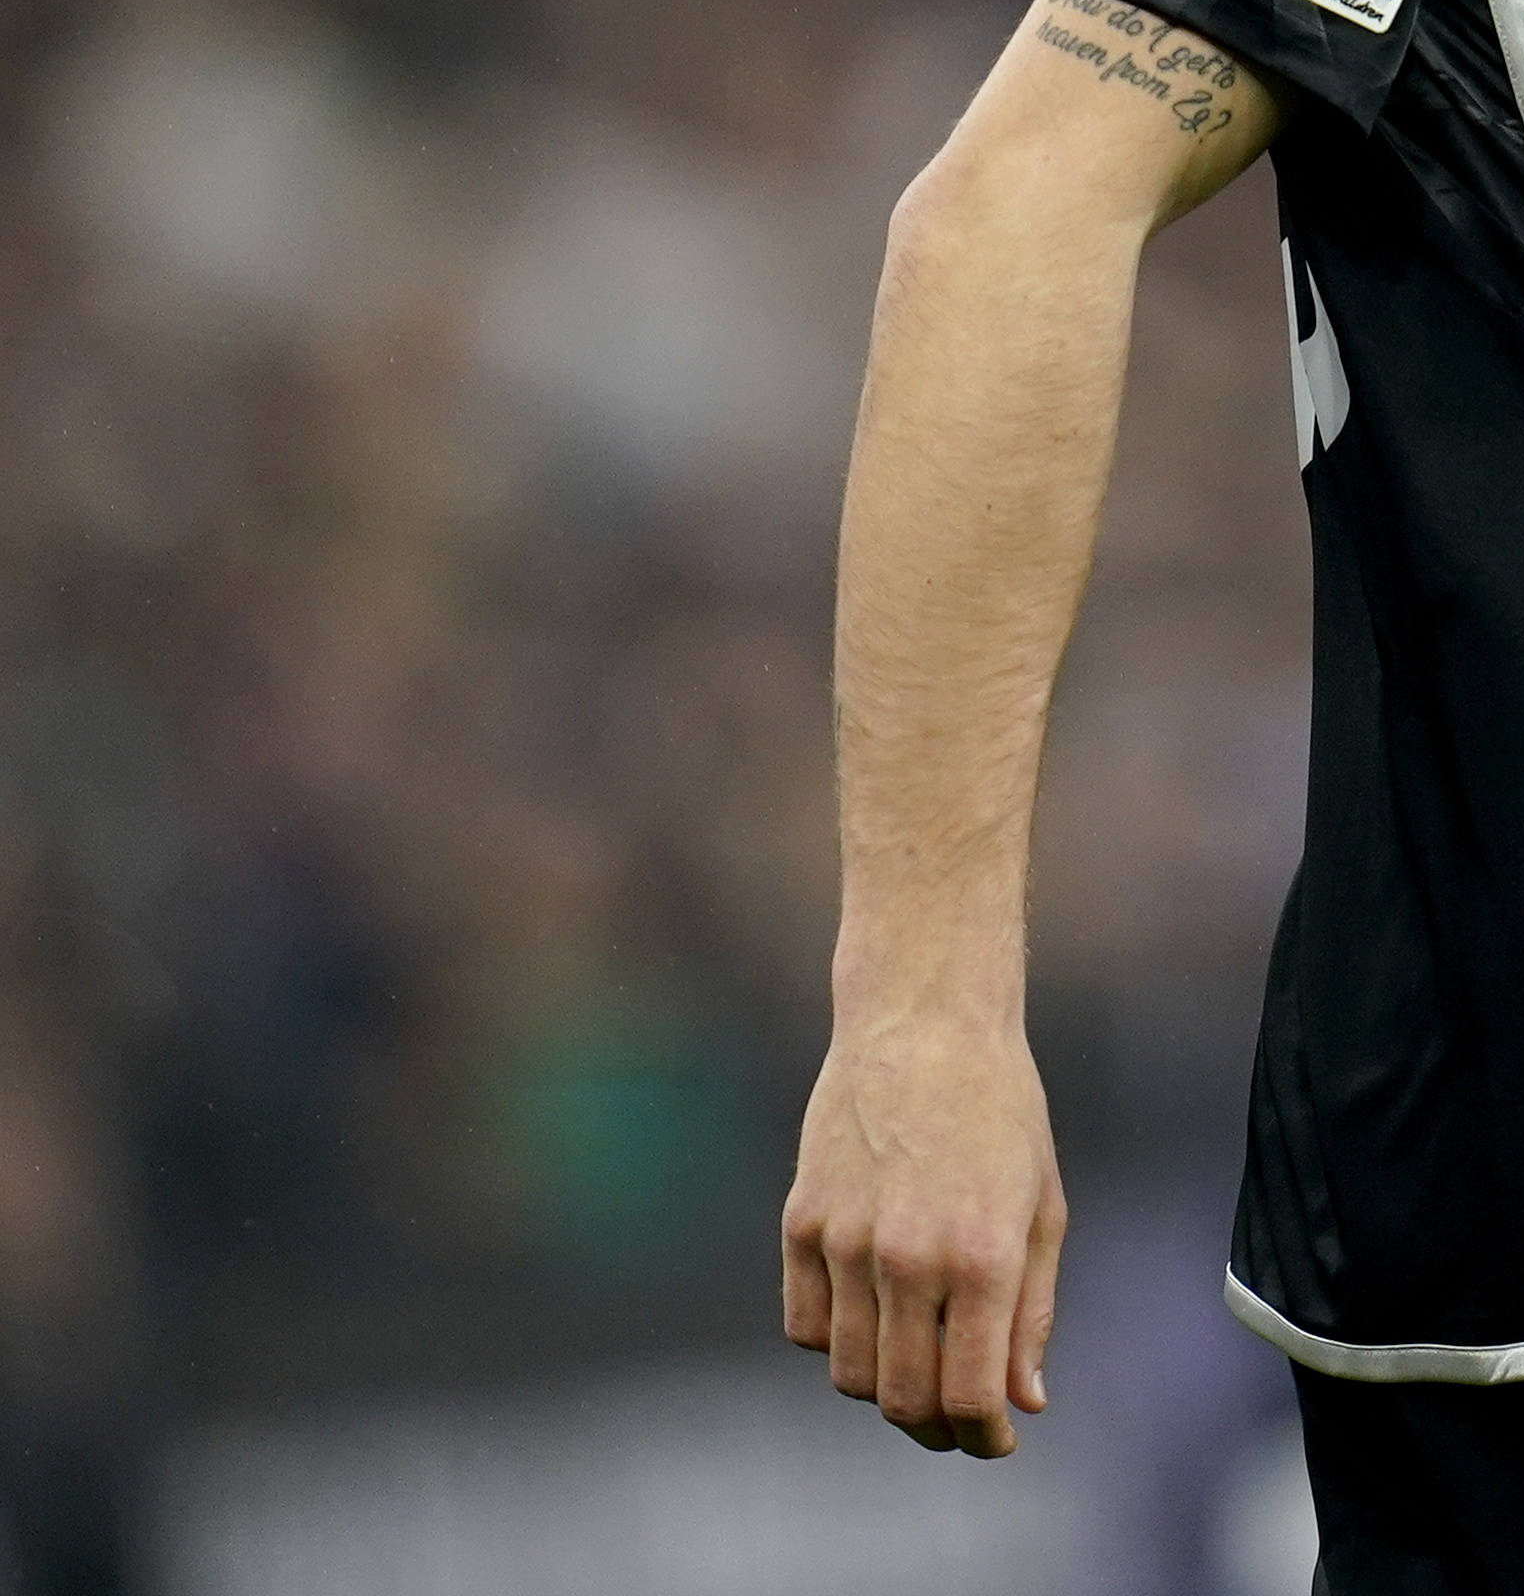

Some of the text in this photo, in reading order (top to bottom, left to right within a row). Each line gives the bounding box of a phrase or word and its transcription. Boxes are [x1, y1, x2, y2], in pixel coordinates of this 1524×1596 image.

[1107, 6, 1144, 37] do
[1036, 13, 1108, 67] heaven
[1099, 51, 1171, 101] from
